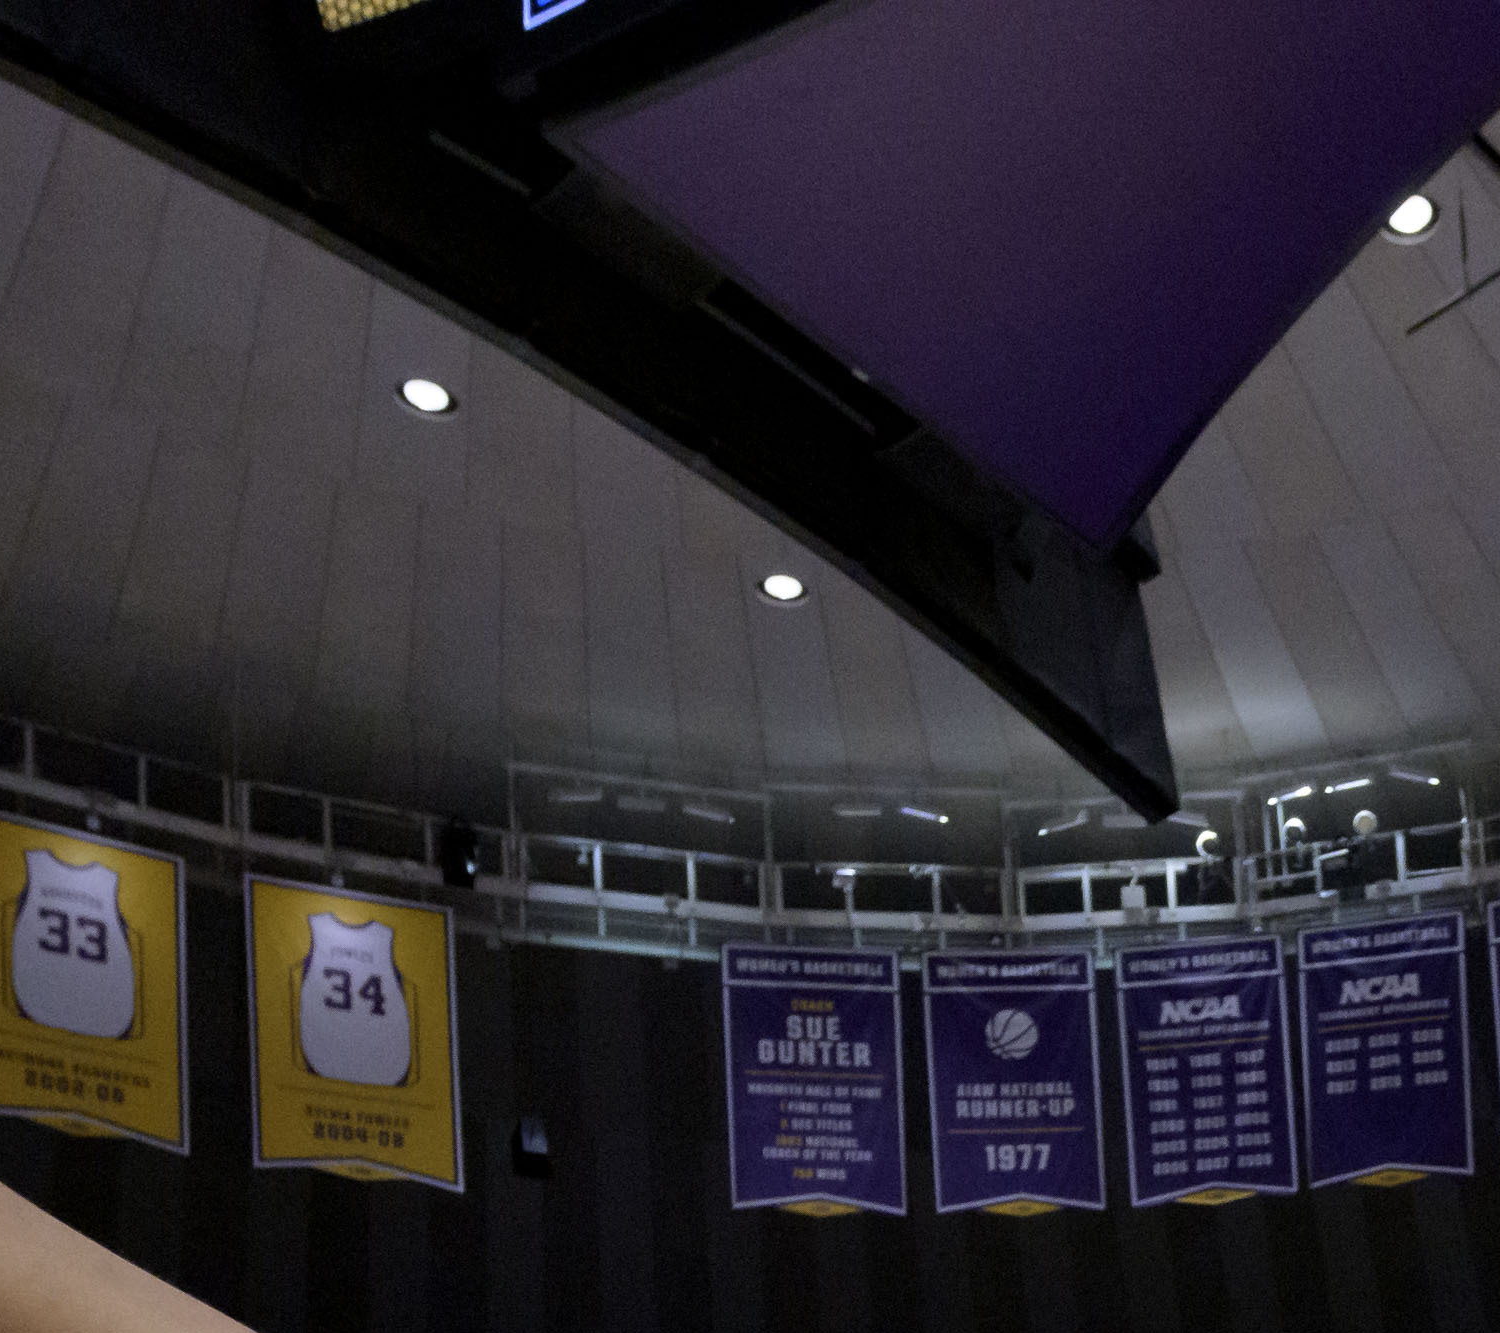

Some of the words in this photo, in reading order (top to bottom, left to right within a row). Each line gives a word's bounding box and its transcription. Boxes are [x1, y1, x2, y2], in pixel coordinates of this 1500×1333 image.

[38, 907, 108, 965] 33
[323, 967, 386, 1017] 34
[1339, 972, 1421, 1005] NCAA
[1160, 994, 1241, 1025] NCAA
[786, 1014, 841, 1040] SUE
[758, 1038, 872, 1067] GUNTER
[1000, 1081, 1073, 1097] NATIONAL
[956, 1097, 1076, 1119] RUNNER-UP
[985, 1144, 1051, 1172] 1977
